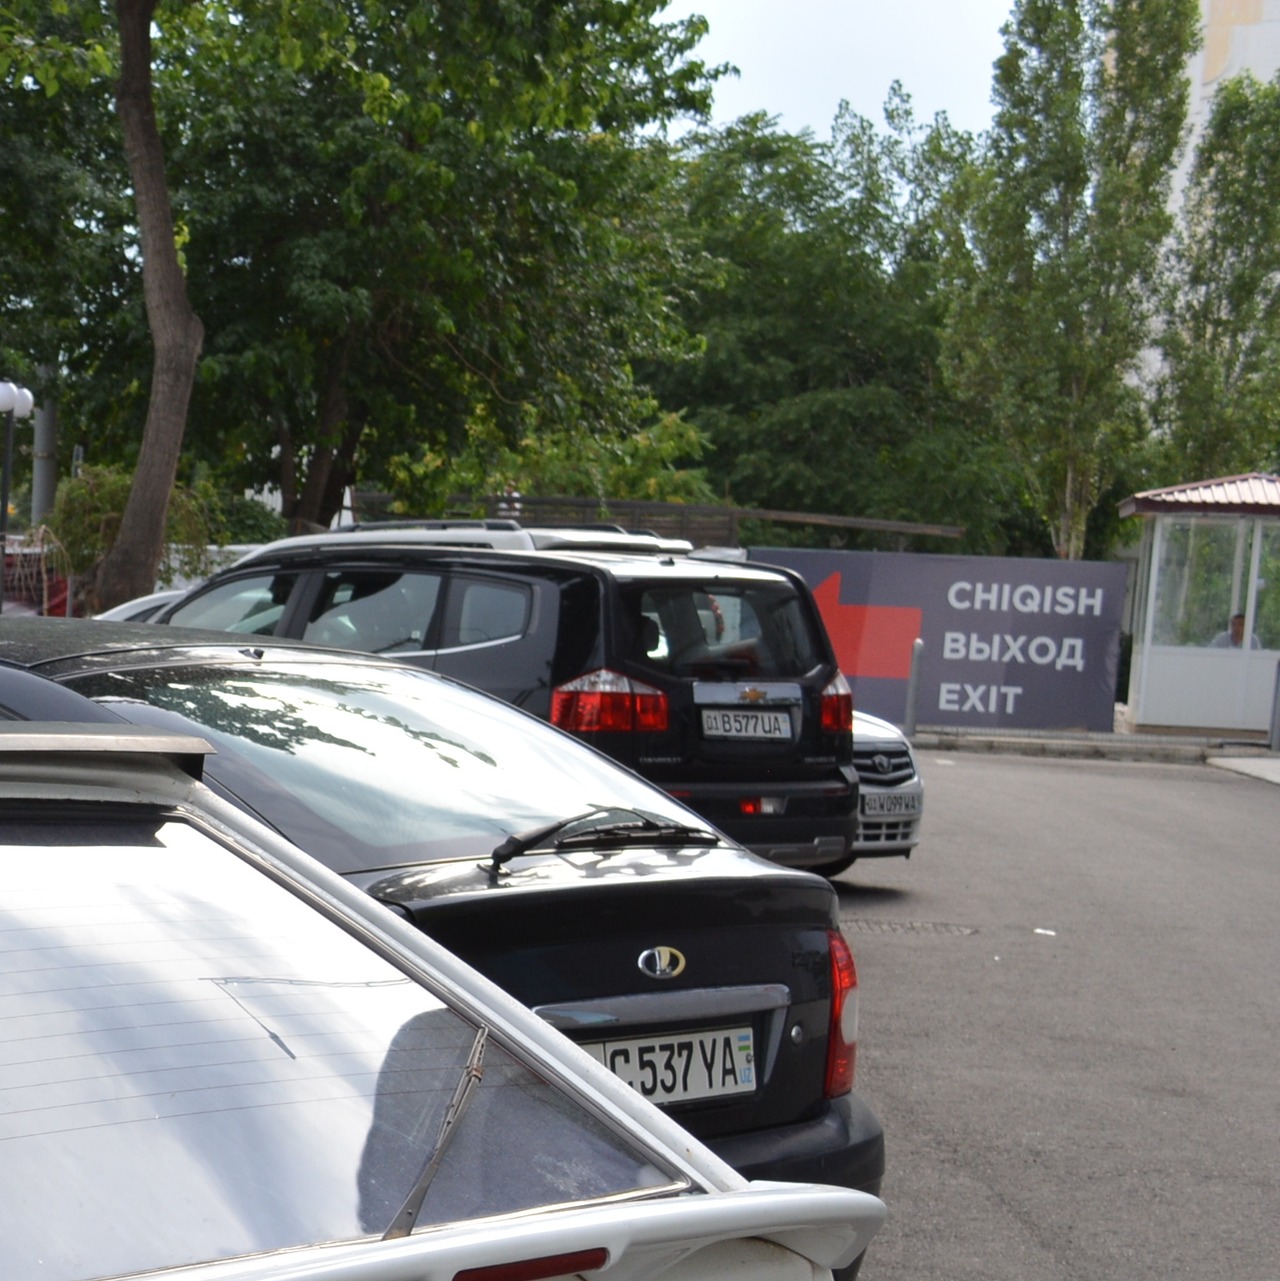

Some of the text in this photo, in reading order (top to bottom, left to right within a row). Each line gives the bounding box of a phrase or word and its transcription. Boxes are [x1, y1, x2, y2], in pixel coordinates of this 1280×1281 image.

[947, 581, 1103, 616] CHIQISH
[943, 631, 1085, 672] ВЫХОД
[938, 682, 1023, 714] EXIT
